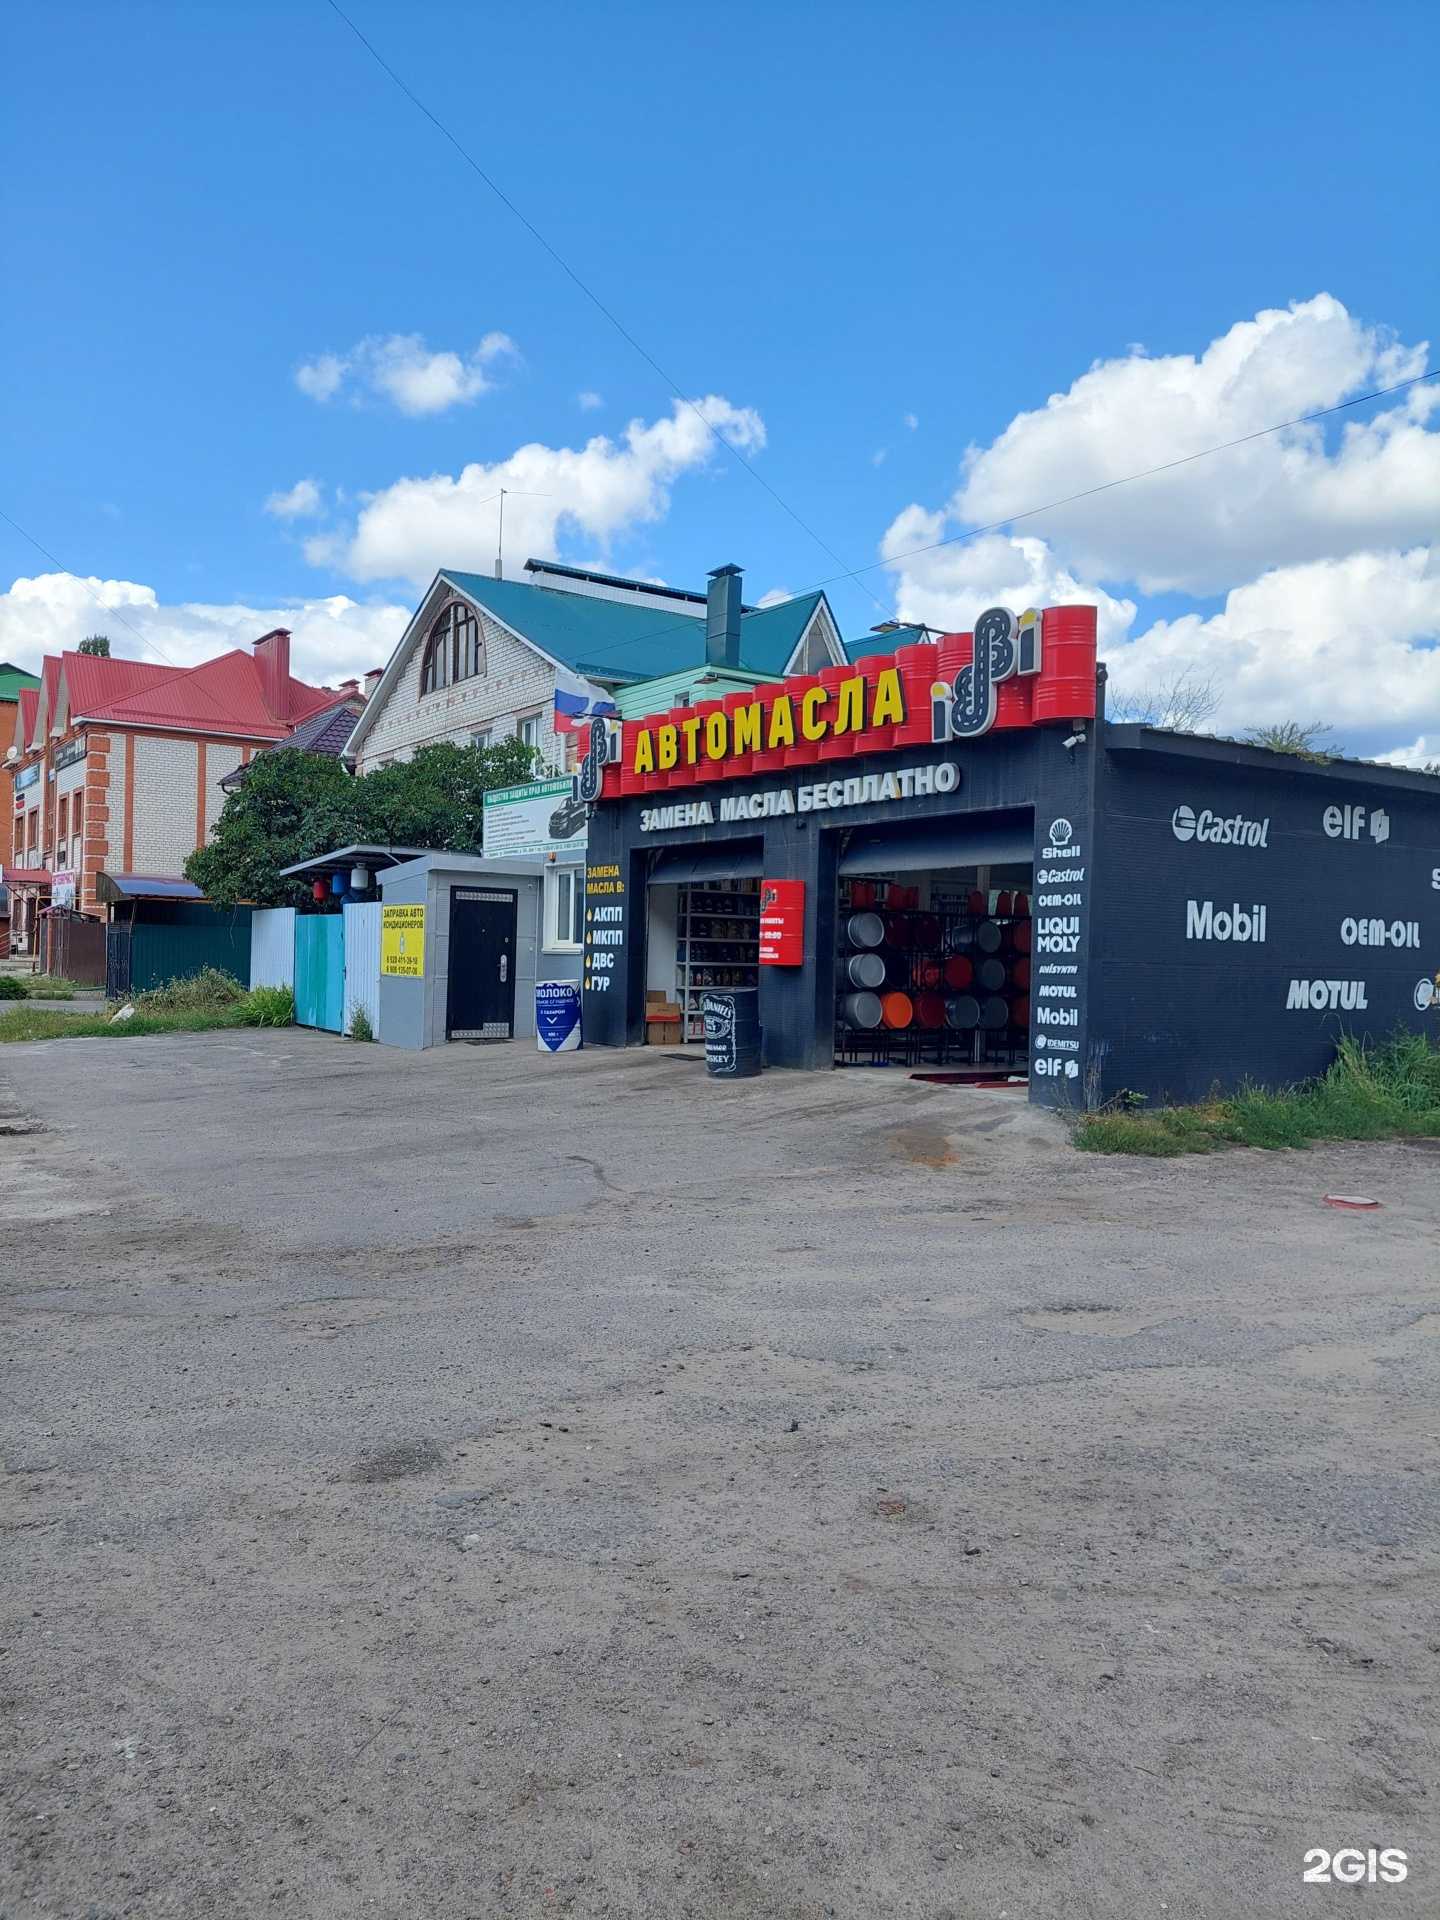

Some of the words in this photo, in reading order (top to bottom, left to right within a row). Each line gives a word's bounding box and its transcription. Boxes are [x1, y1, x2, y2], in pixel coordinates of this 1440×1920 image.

[634, 668, 905, 774] АВТОМАСЛА
[640, 801, 714, 832] ЗАМЕНА
[720, 788, 795, 822] МАСЛА
[797, 762, 960, 812] БЕСПЛАТНО
[1196, 808, 1270, 848] Castrol
[1323, 804, 1366, 840] elf
[1042, 845, 1081, 859] Shell
[587, 865, 620, 879] ЗАМЕНА
[1048, 867, 1085, 883] Castrol
[586, 882, 614, 895] МАСЛА
[383, 908, 409, 918] ЗАПРАВКА
[409, 908, 424, 918] АВТО
[593, 906, 623, 922] АКПП
[1186, 900, 1267, 942] Mobil
[1037, 916, 1080, 935] LIQUI
[1340, 917, 1421, 948] OEM-OIL
[592, 930, 623, 945] МКПП
[1037, 935, 1081, 953] MOLY
[592, 952, 614, 970] ДВС
[591, 976, 610, 992] ГУР
[1039, 984, 1078, 998] MOTUL
[1286, 979, 1368, 1010] MOTUL
[1037, 1006, 1078, 1026] Mobil
[1034, 1057, 1062, 1077] elf
